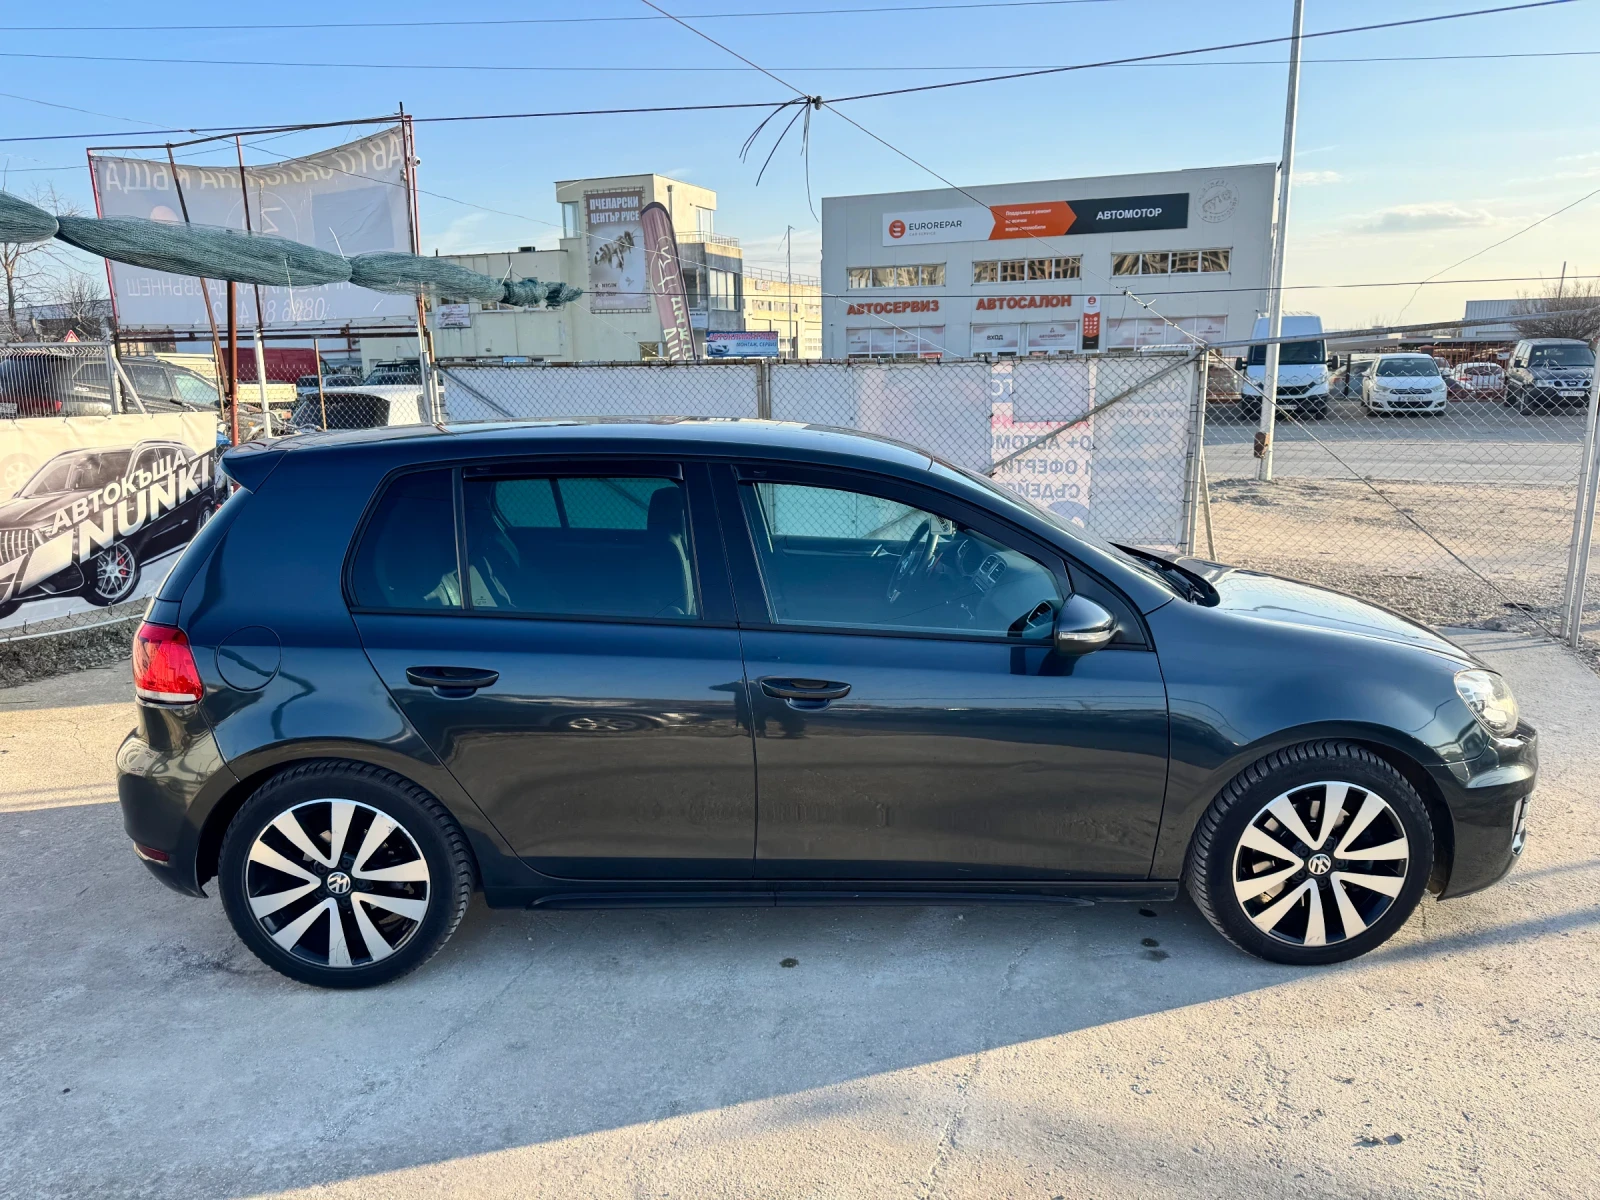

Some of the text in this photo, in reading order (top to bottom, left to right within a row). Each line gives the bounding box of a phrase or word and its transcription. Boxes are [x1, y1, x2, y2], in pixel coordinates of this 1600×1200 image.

[589, 196, 639, 211] ПЧЕЛАРСКИ
[590, 210, 640, 225] ЦЕНТЪР РУСЕ
[1096, 208, 1163, 221] АВТОМОТОР
[908, 220, 963, 231] EUROREPAR
[847, 300, 939, 315] АВТОСЕРВИЗ
[976, 295, 1072, 311] АВТОСАЛОН
[708, 332, 777, 341] АВТОКЛИМАТИЦИ
[50, 449, 189, 535] АВТОКЪЩА
[79, 454, 210, 565] NUNKI
